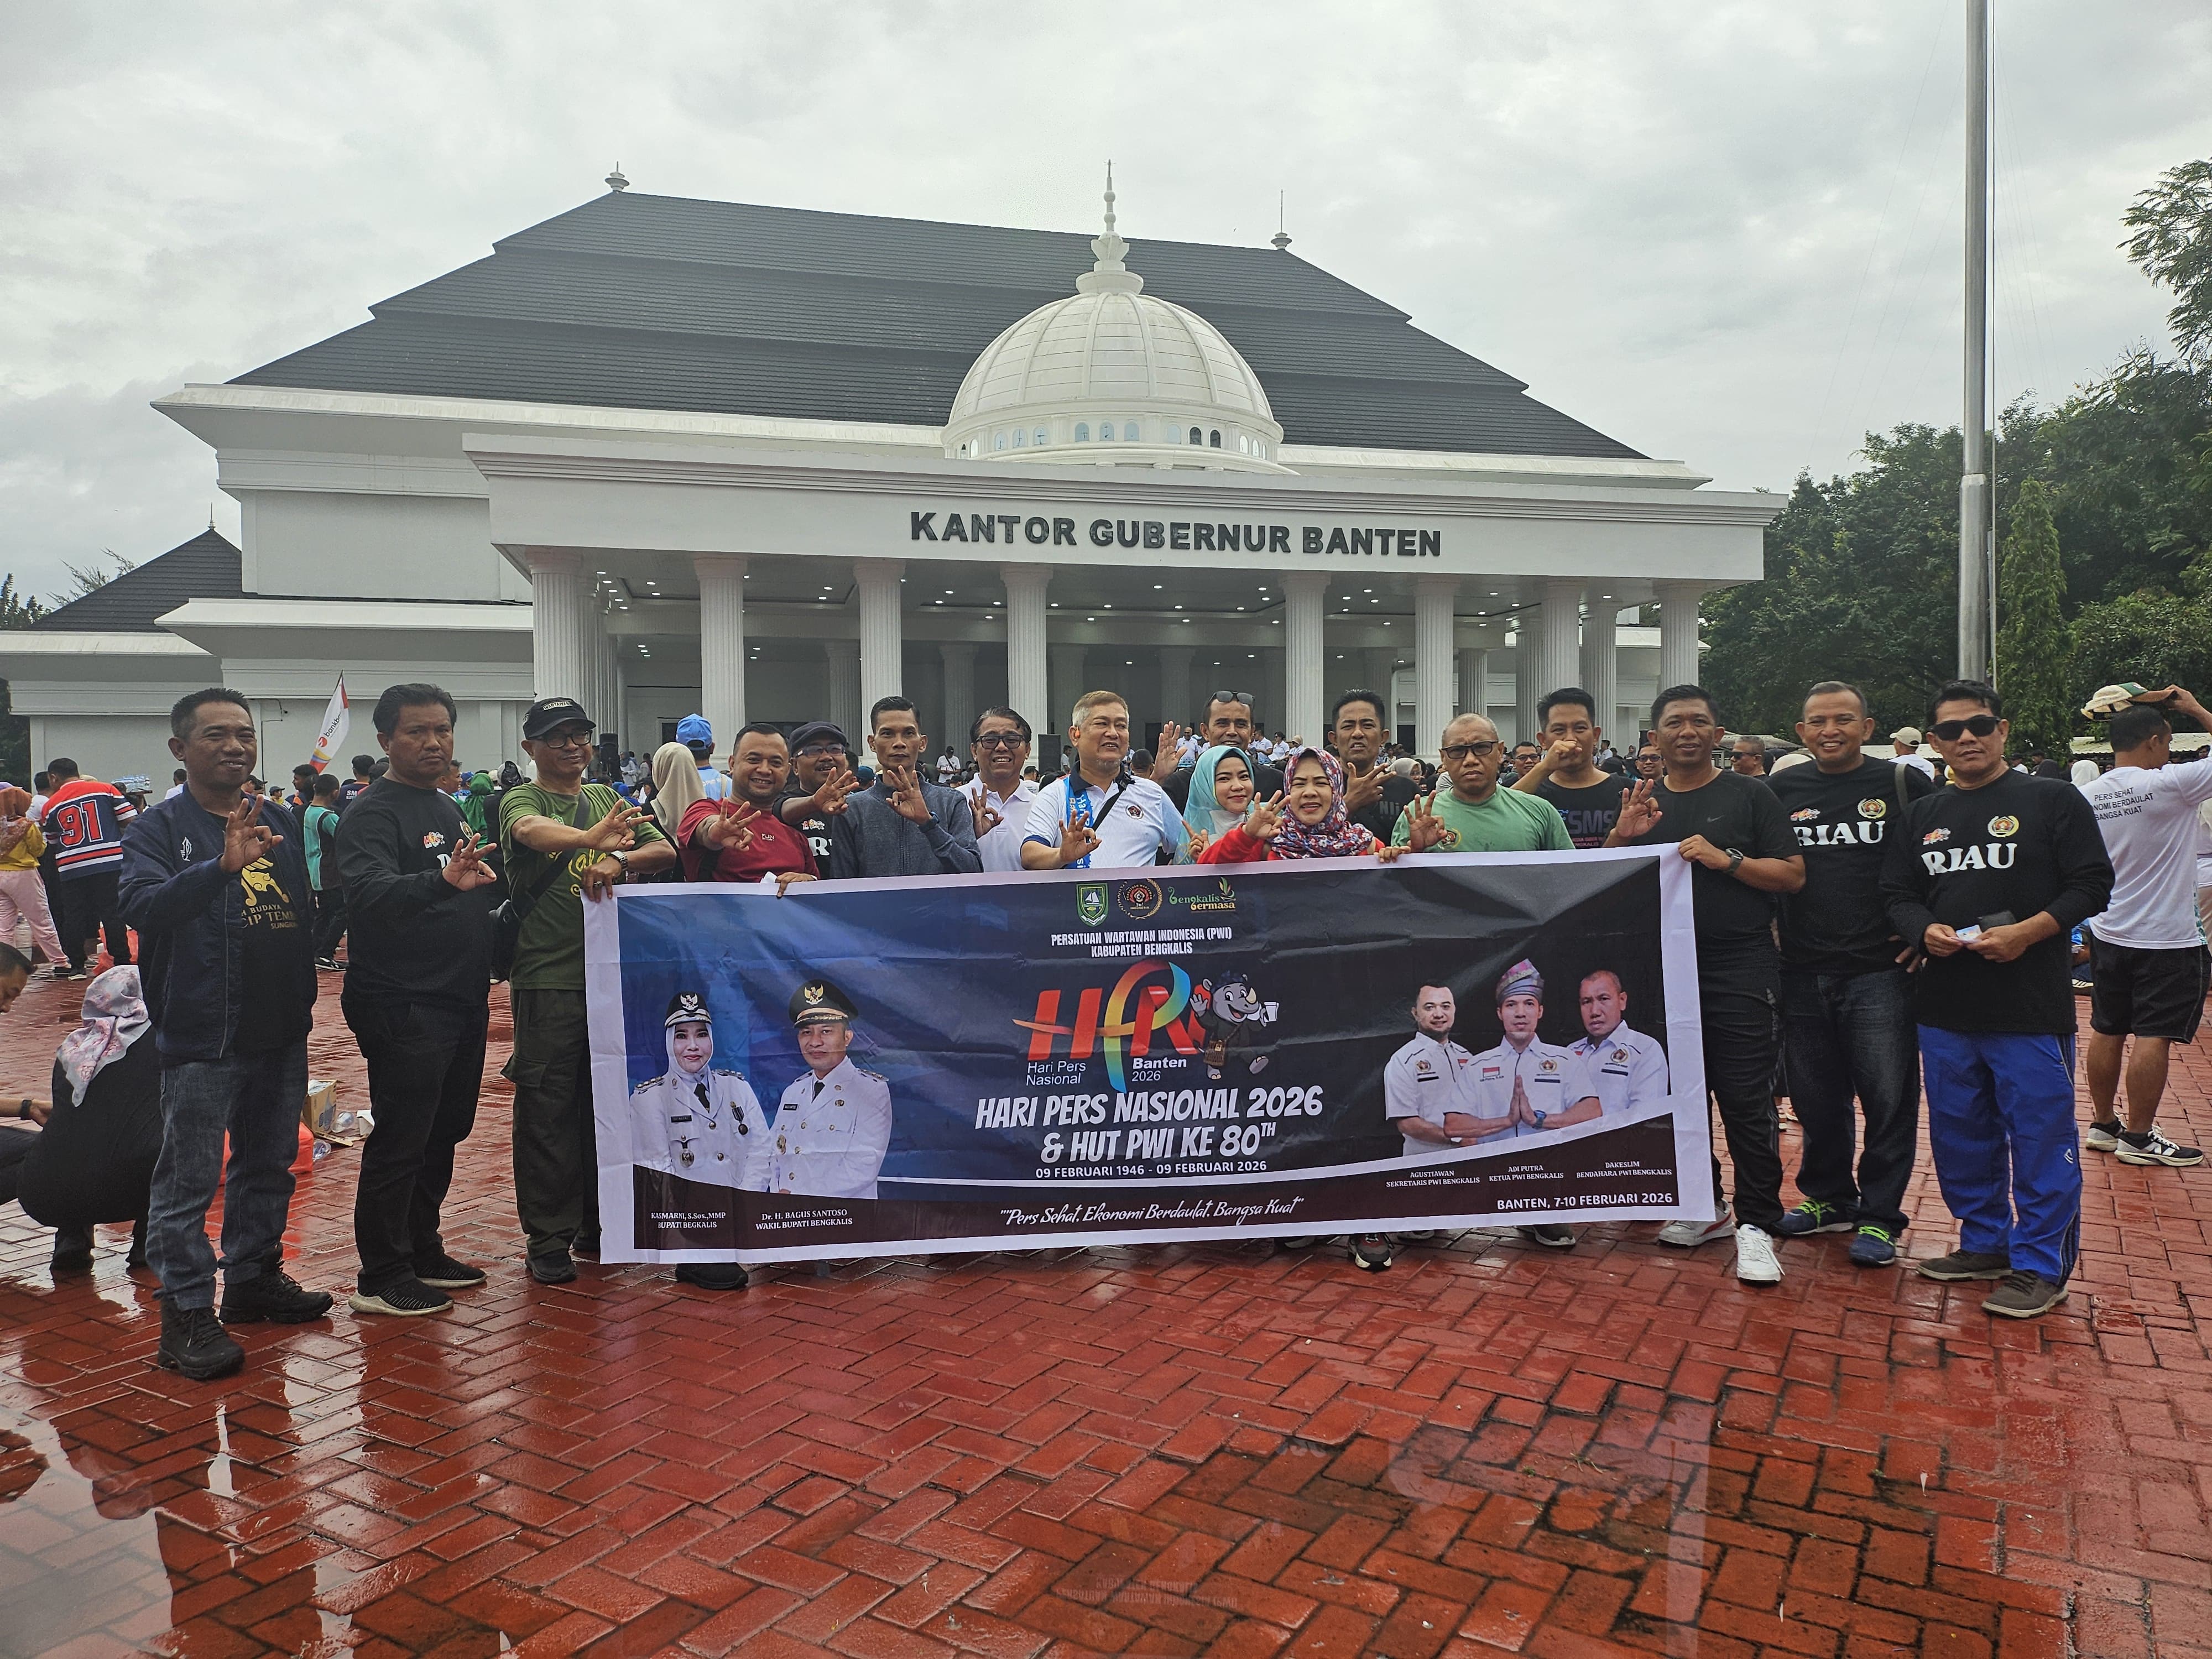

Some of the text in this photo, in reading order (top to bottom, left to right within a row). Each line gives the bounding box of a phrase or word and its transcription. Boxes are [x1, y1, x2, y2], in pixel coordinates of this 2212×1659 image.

[911, 512, 1440, 556] KANTOR GUBERNUR BANTEN
[2112, 792, 2154, 808] BERDAULAT
[2114, 787, 2134, 799] SEHAT
[2124, 806, 2142, 816] KUAT
[57, 799, 104, 848] 91
[1793, 821, 1886, 847] RIAU
[1921, 843, 2018, 876] RIAU
[249, 904, 282, 914] BUDAYA
[1051, 926, 1233, 946] PERSATUAN WARTAWAN INDONESIA (PWI)
[1091, 942, 1193, 958] KABUPATEN BENGKALIS
[1027, 1060, 1087, 1074] Hari Pers
[1133, 1057, 1187, 1070] Banten
[1026, 1073, 1081, 1086] Nasional
[1131, 1070, 1161, 1082] 2026
[975, 1085, 1323, 1129] HARI PERS NASIONAL 2026
[1040, 1132, 1064, 1164] &
[1070, 1129, 1120, 1162] HUT
[1125, 1128, 1175, 1161] PWI
[1180, 1126, 1214, 1159] KE
[1035, 1168, 1051, 1178] 09
[1055, 1166, 1113, 1178] FEBRUARI
[1116, 1165, 1145, 1176] 1946
[1156, 1164, 1171, 1175] 09
[1175, 1162, 1234, 1174] FEBRUARI
[1237, 1161, 1267, 1172] 2026
[1410, 1170, 1454, 1178] AGUSTIAWAN
[1576, 1170, 1617, 1178] BENDAHARA
[1442, 1177, 1480, 1185] BENGKALIS
[1496, 1192, 1673, 1210] BANTEN, 7-10 FEBRUARI 2026
[651, 1212, 687, 1220] KASMARNI,
[785, 1211, 811, 1219] BAGUS
[812, 1209, 847, 1217] SANTOSO
[1082, 1202, 1145, 1223] Ekonomi
[1213, 1201, 1264, 1226] Bangsa
[755, 1218, 853, 1230] WAKIL BUPATI BENGKALIS
